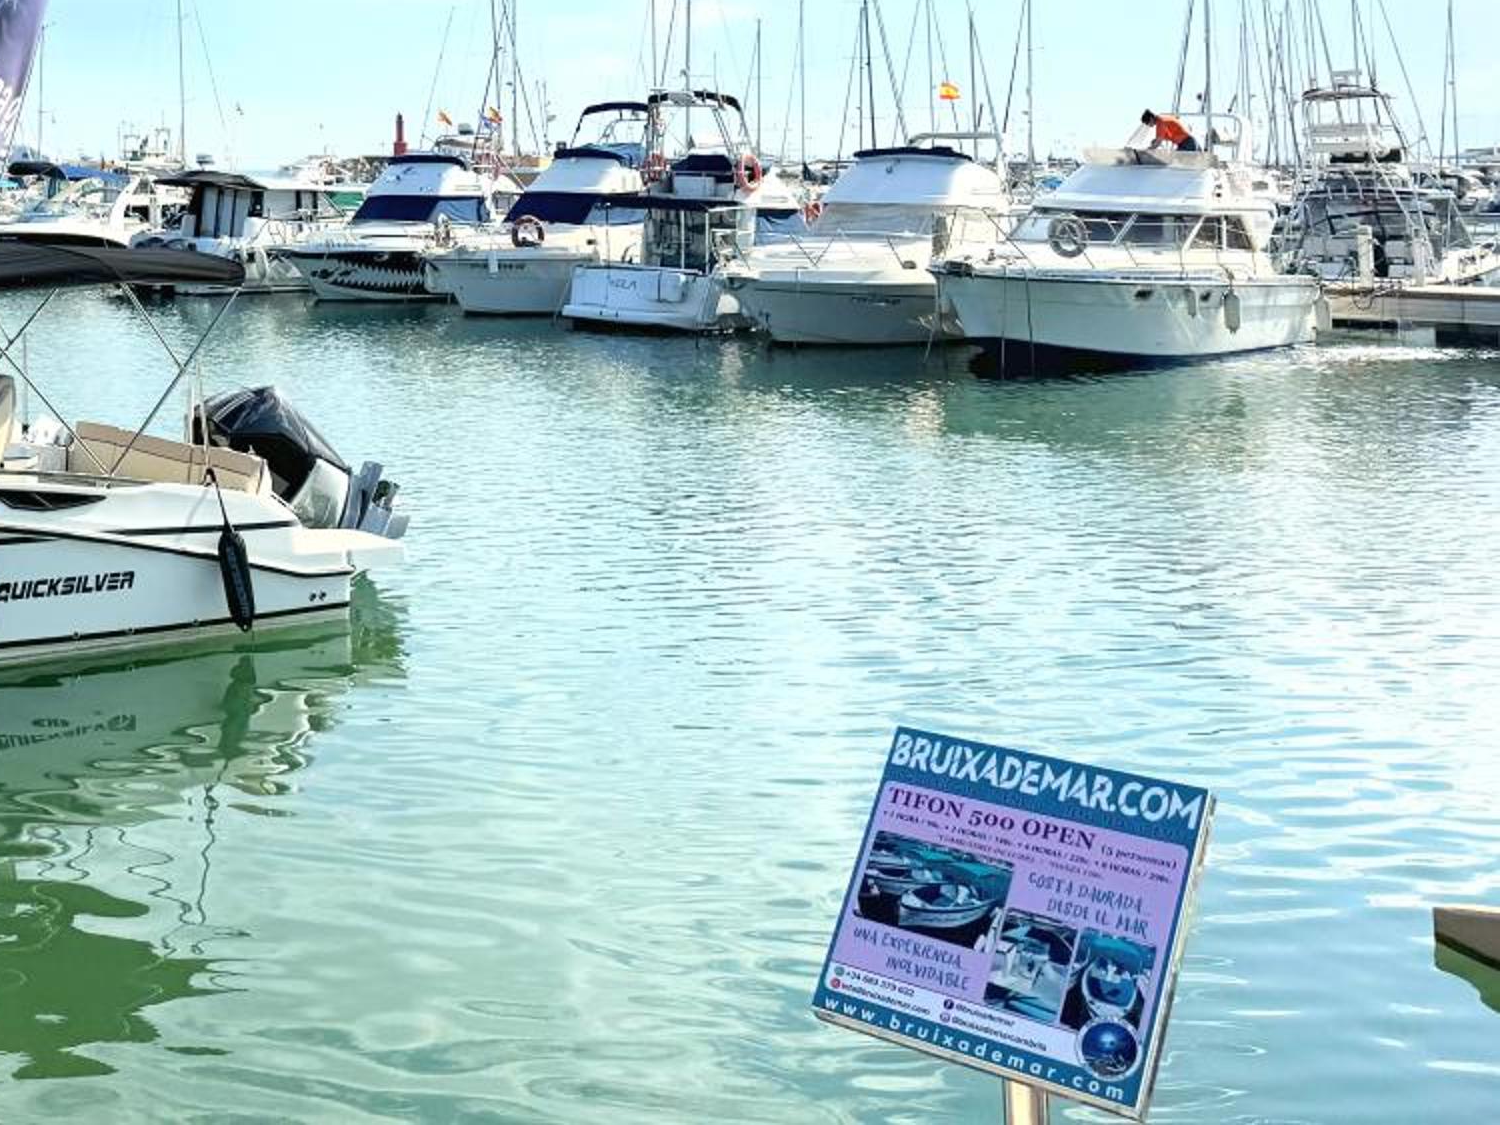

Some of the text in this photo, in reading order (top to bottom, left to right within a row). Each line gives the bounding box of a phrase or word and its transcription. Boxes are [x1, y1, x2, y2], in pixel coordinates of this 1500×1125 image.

[891, 732, 1206, 831] BRUIXADEMAR.COM
[888, 786, 964, 819] TIFON
[967, 809, 1015, 832] 500
[1022, 817, 1096, 852] OPEN
[1028, 871, 1073, 897] COSTA
[853, 926, 877, 945] UNA
[1115, 916, 1149, 939] MAR
[885, 954, 972, 991] INOLVIDABLE
[825, 995, 1126, 1102] www.bruixademar.com
